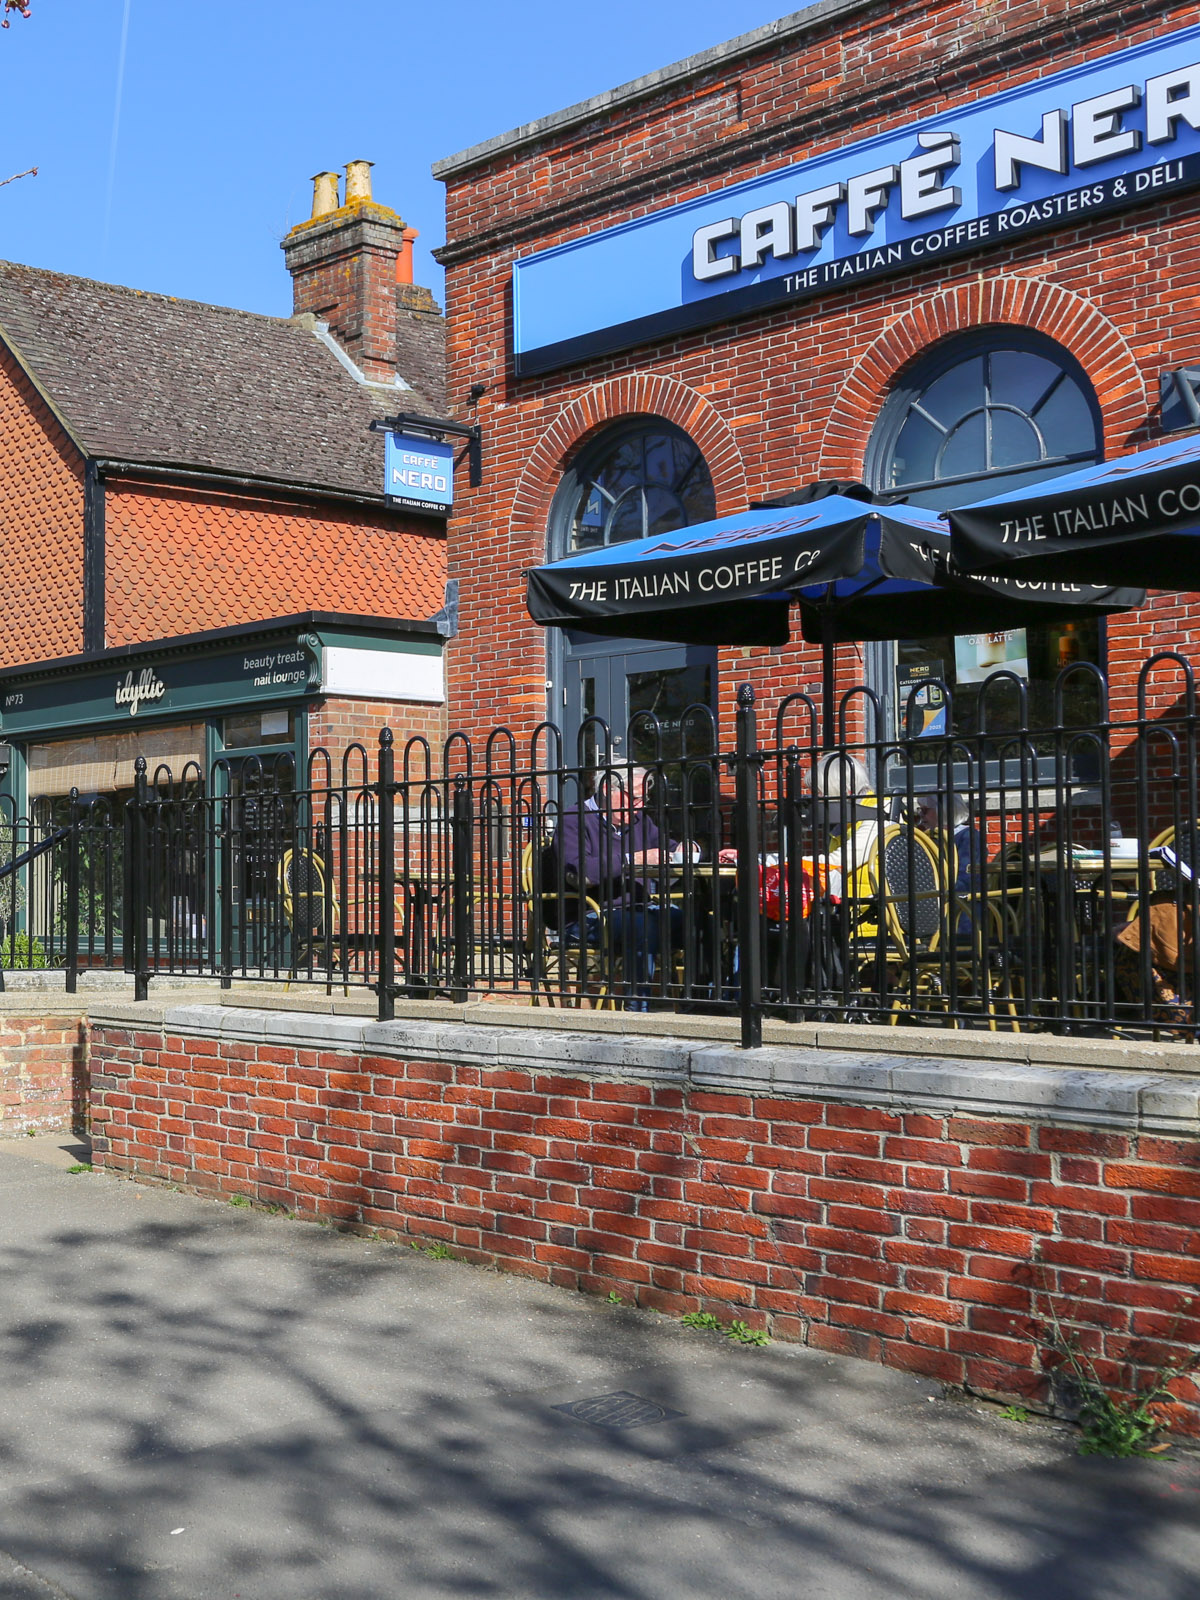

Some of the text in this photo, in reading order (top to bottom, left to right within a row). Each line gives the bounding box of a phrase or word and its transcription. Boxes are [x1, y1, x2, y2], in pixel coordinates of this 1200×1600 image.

[693, 132, 961, 281] CAFFÈ
[784, 162, 1184, 293] THE ITALIAN COFFEE ROASTERS & DELI
[392, 467, 447, 492] NERO
[392, 496, 402, 504] THE
[402, 498, 420, 508] ITALIAN
[421, 502, 439, 511] COFFEE
[1000, 515, 1047, 543] THE
[1052, 494, 1149, 536] ITALIAN
[568, 581, 607, 601] THE
[614, 571, 690, 600] ITALIAN
[698, 556, 783, 592] COFFEE
[968, 633, 1013, 646] OAT LATTE
[243, 650, 305, 670] beauty treats
[115, 667, 165, 716] idyllic
[254, 670, 306, 687] nail lounge
